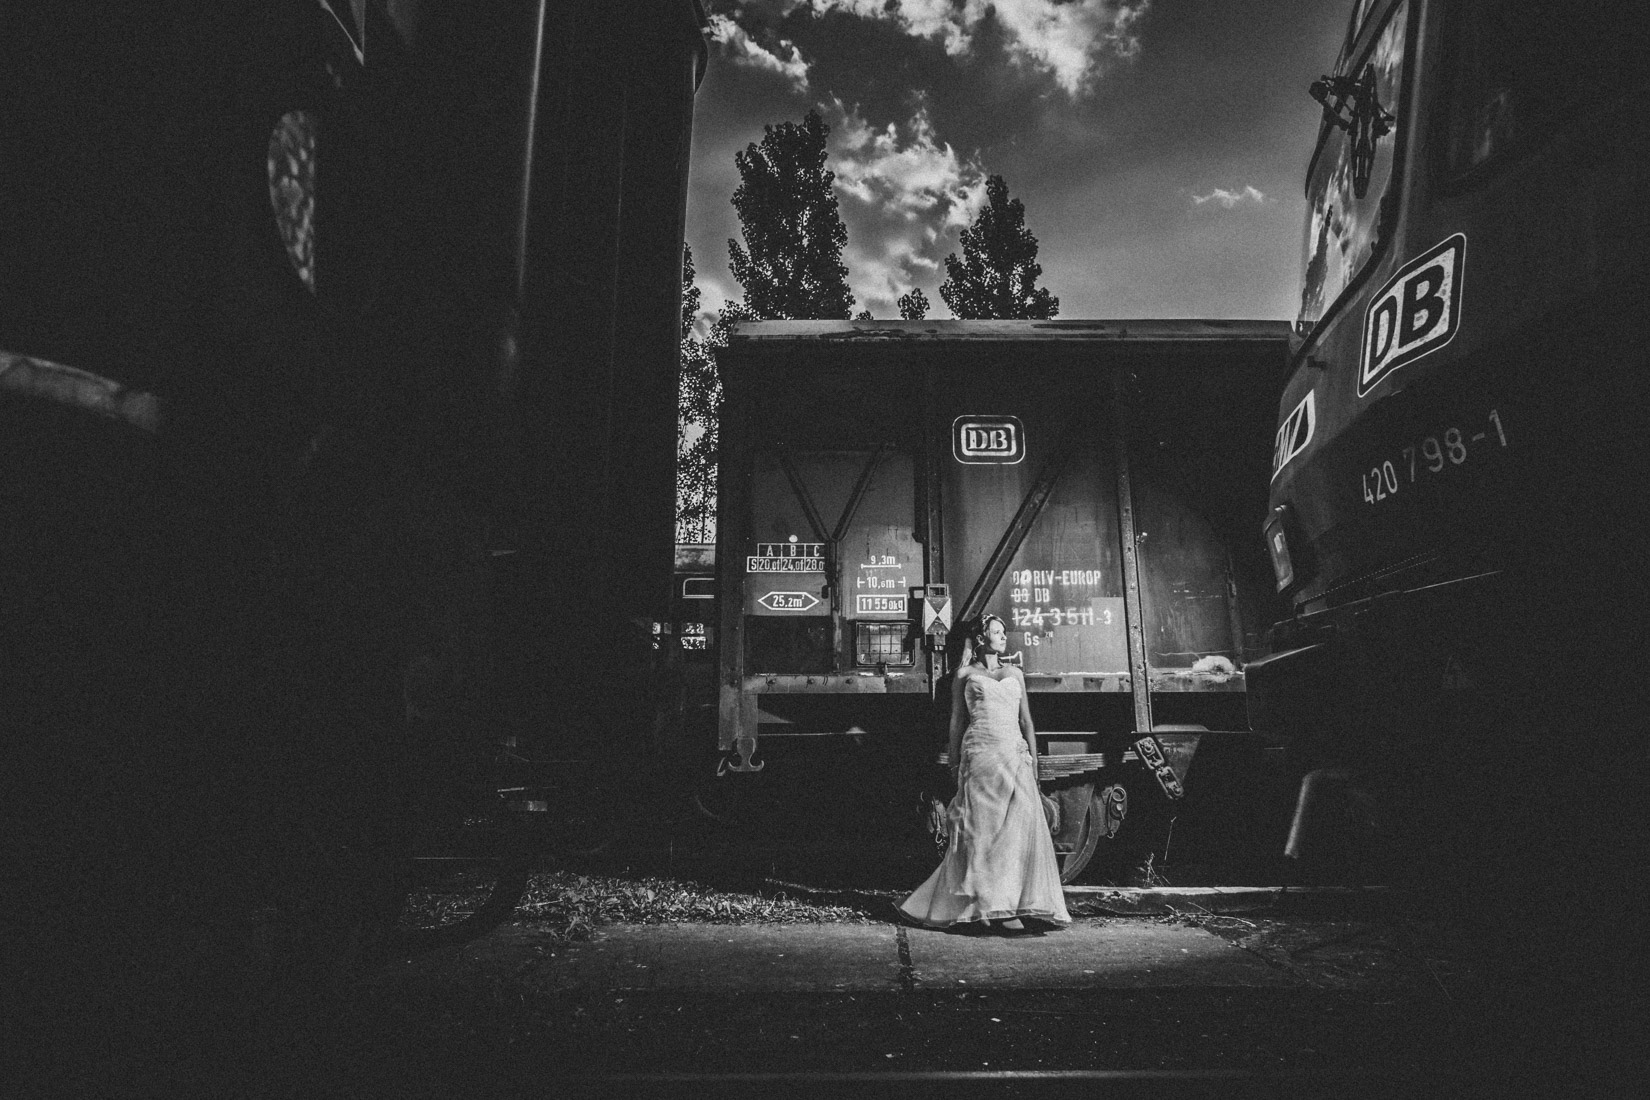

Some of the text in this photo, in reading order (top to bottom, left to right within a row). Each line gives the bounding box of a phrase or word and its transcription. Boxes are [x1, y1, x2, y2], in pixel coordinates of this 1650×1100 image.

[1366, 263, 1447, 380] DB
[967, 429, 1008, 450] DB
[1362, 408, 1507, 504] 420 798-1
[766, 545, 820, 557] A B C
[750, 558, 757, 570] S
[1033, 570, 1101, 586] RIV-EUROP
[1034, 588, 1050, 603] DB
[1024, 631, 1040, 646] Gs
